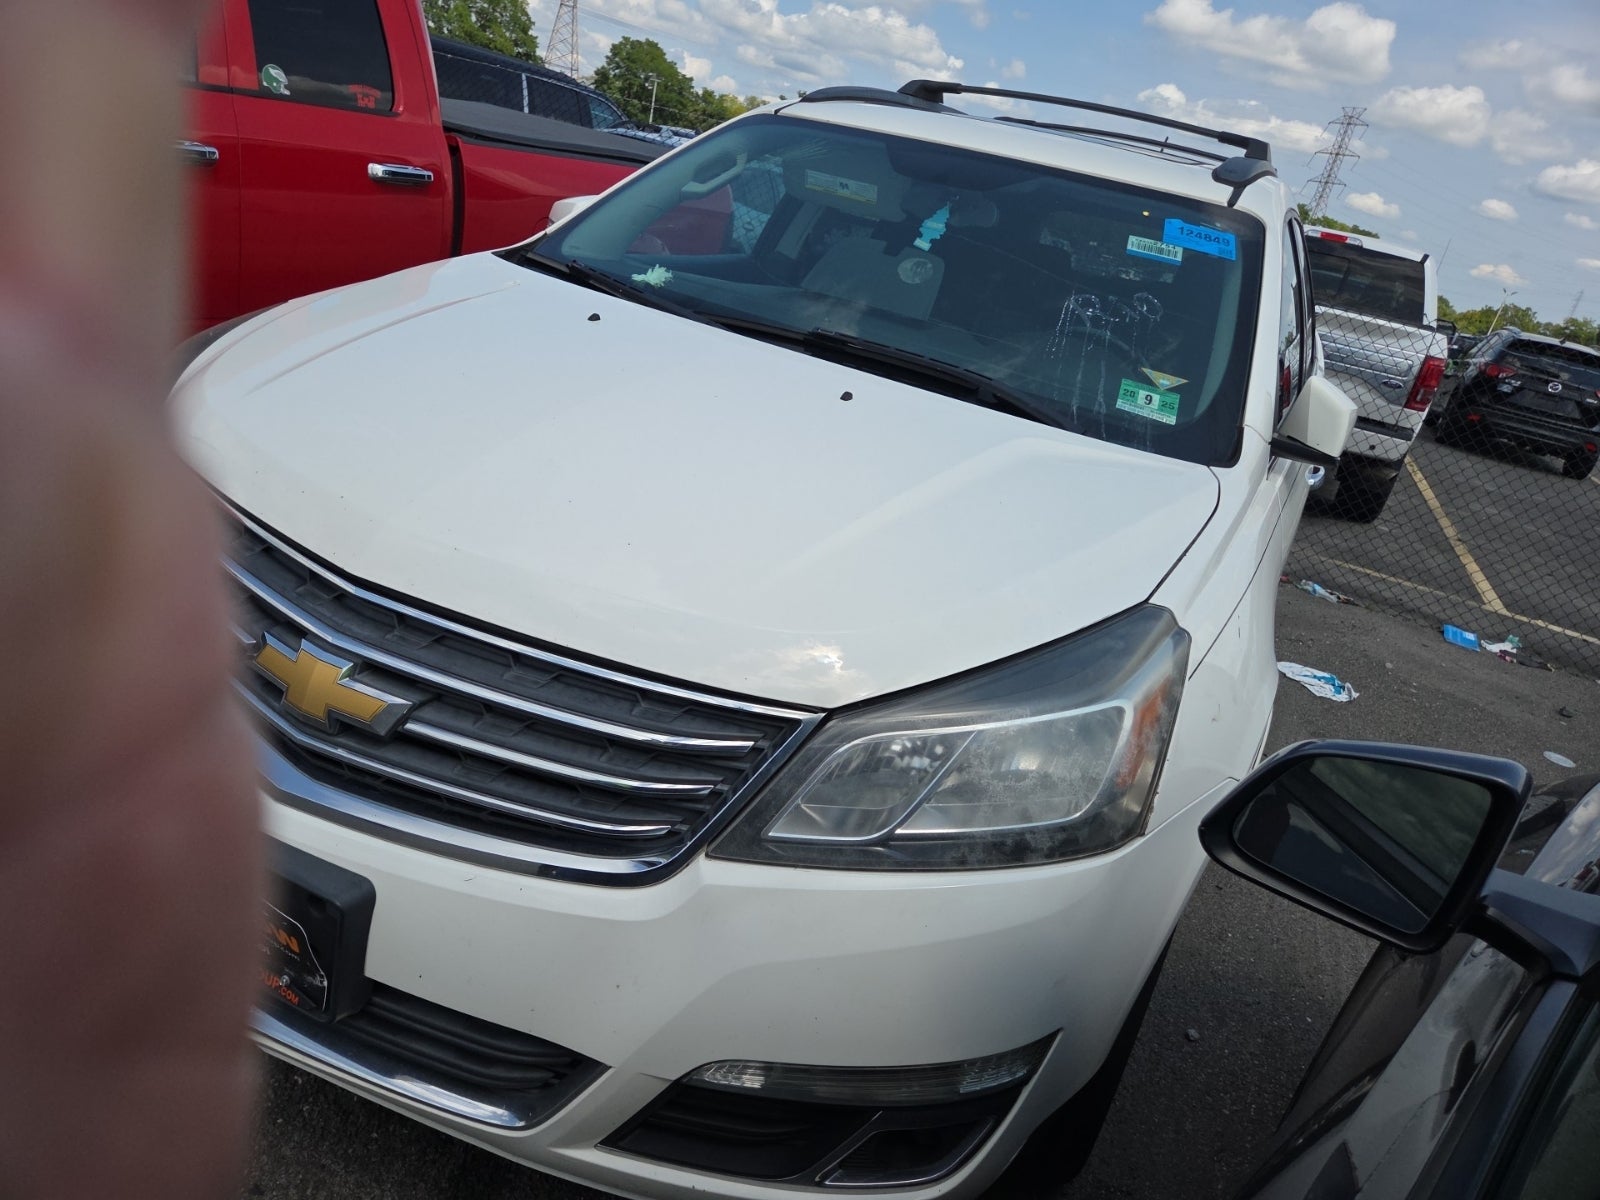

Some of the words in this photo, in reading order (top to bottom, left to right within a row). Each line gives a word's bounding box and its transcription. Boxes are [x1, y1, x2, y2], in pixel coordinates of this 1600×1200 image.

[1177, 226, 1231, 247] 124849
[1123, 388, 1136, 398] 20
[1144, 394, 1153, 406] 9
[1161, 400, 1175, 410] 25
